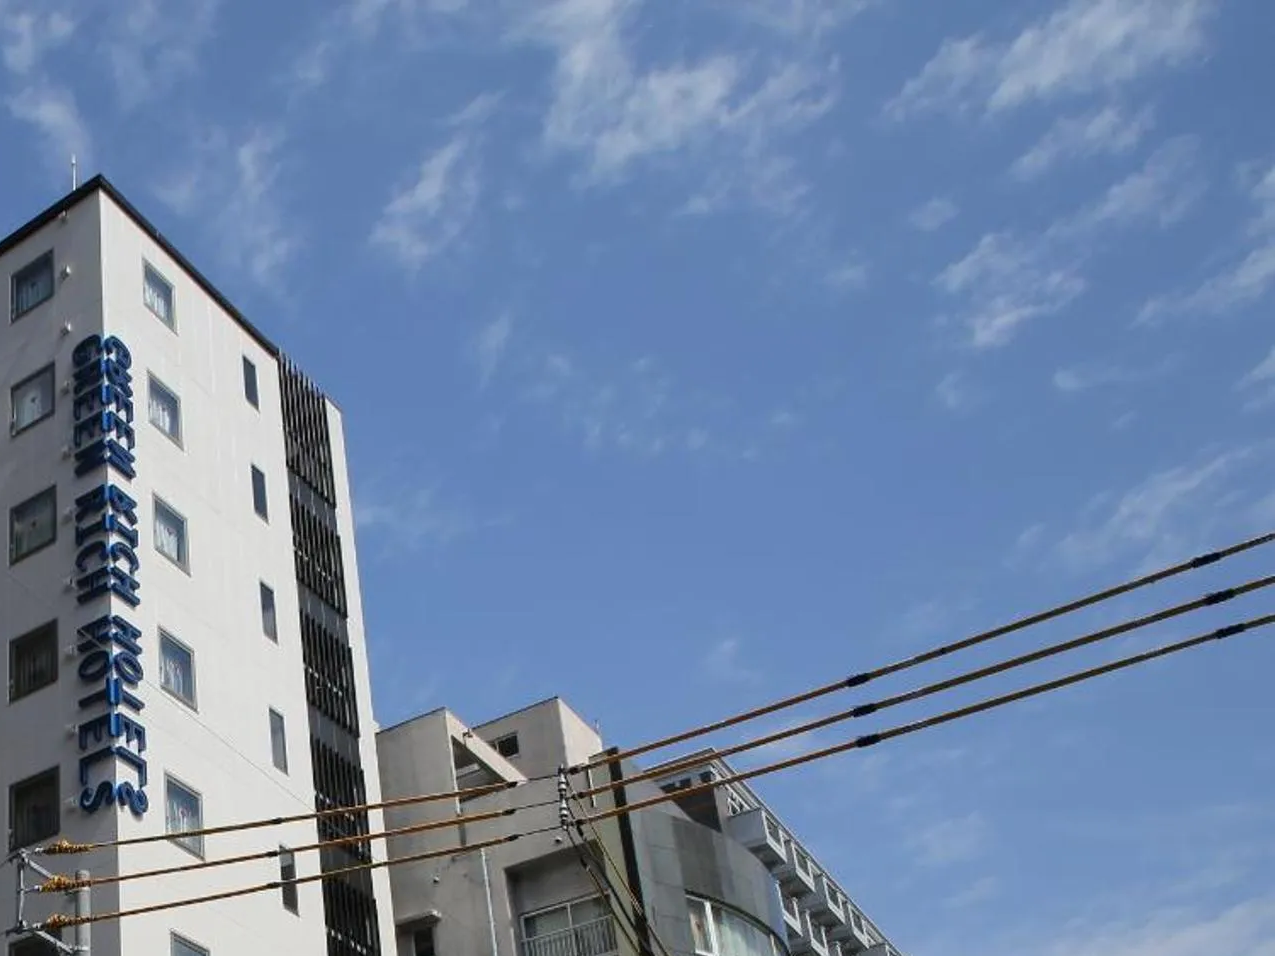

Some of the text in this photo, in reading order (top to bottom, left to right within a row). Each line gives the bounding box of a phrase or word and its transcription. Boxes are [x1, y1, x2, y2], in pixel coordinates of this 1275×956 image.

[72, 334, 117, 814] GREEN RICH HOTELS
